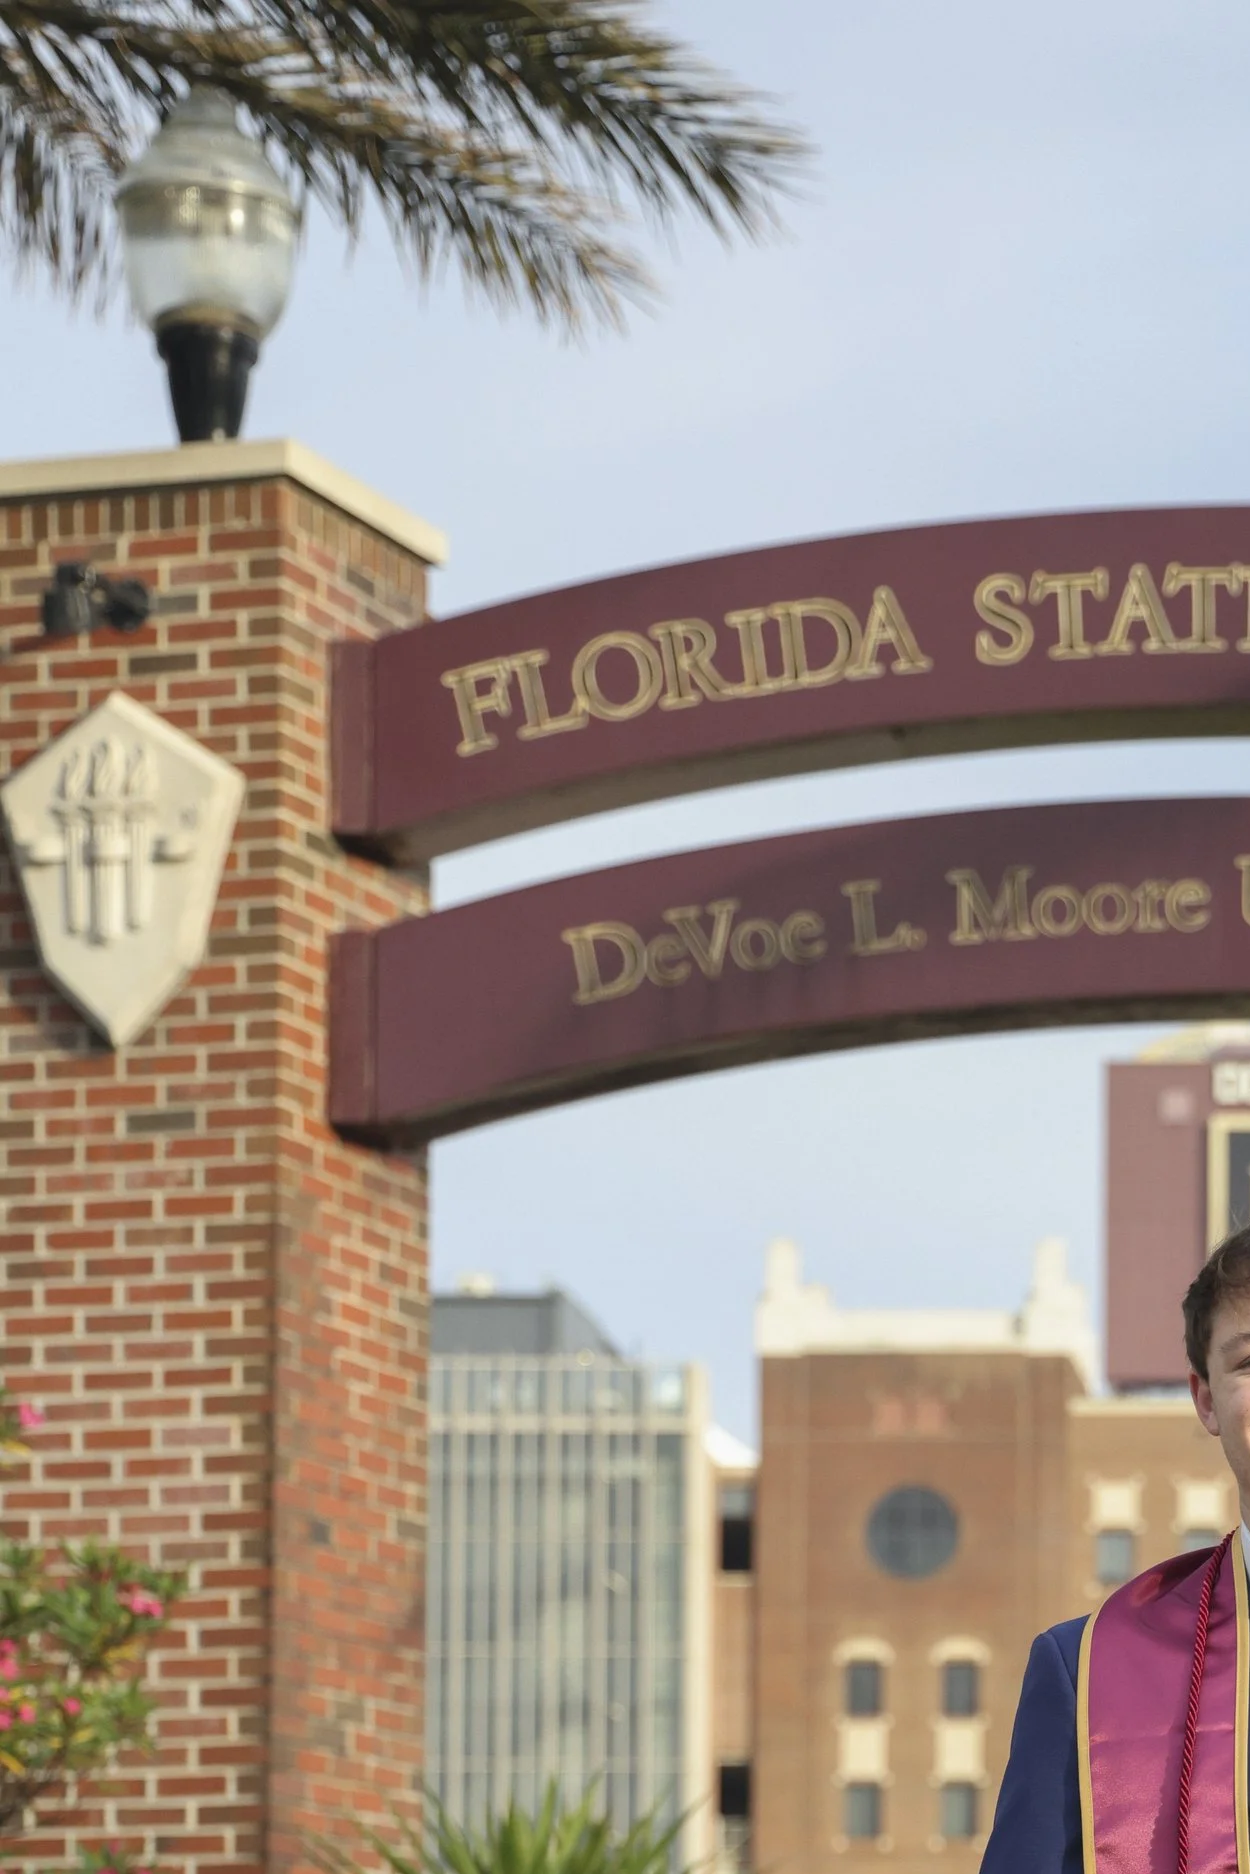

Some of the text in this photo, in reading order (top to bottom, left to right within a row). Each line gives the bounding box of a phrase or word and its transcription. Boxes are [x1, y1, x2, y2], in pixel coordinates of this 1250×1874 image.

[441, 585, 933, 757] FLORIDA
[561, 897, 828, 1005] DeVoe
[840, 878, 927, 956] L.
[947, 865, 1211, 946] Moore
